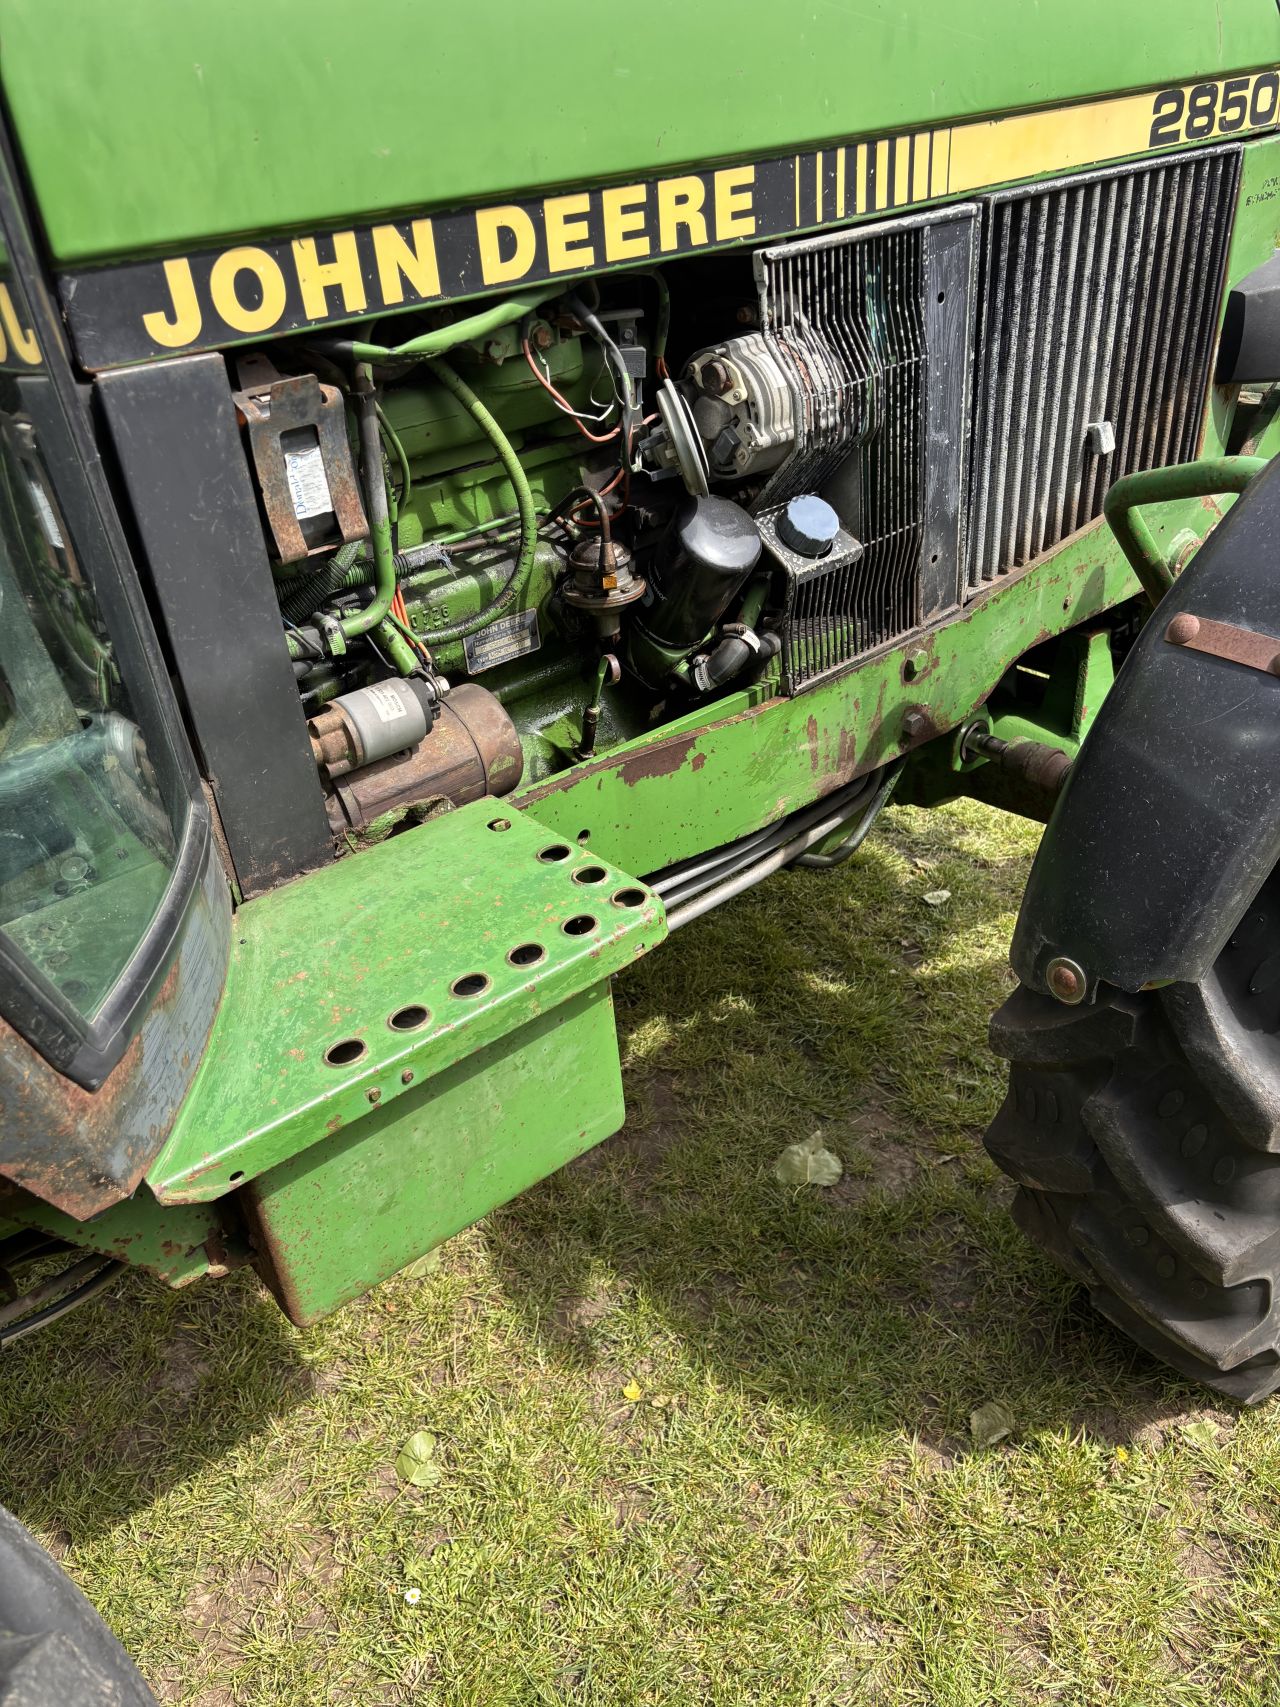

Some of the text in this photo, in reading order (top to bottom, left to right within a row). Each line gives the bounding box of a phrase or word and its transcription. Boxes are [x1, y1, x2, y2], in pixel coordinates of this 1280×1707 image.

[1149, 73, 1279, 148] 2850
[143, 219, 441, 348] JOHN
[475, 165, 756, 286] DEERE
[475, 624, 498, 639] JOHN
[500, 616, 526, 630] DEERE
